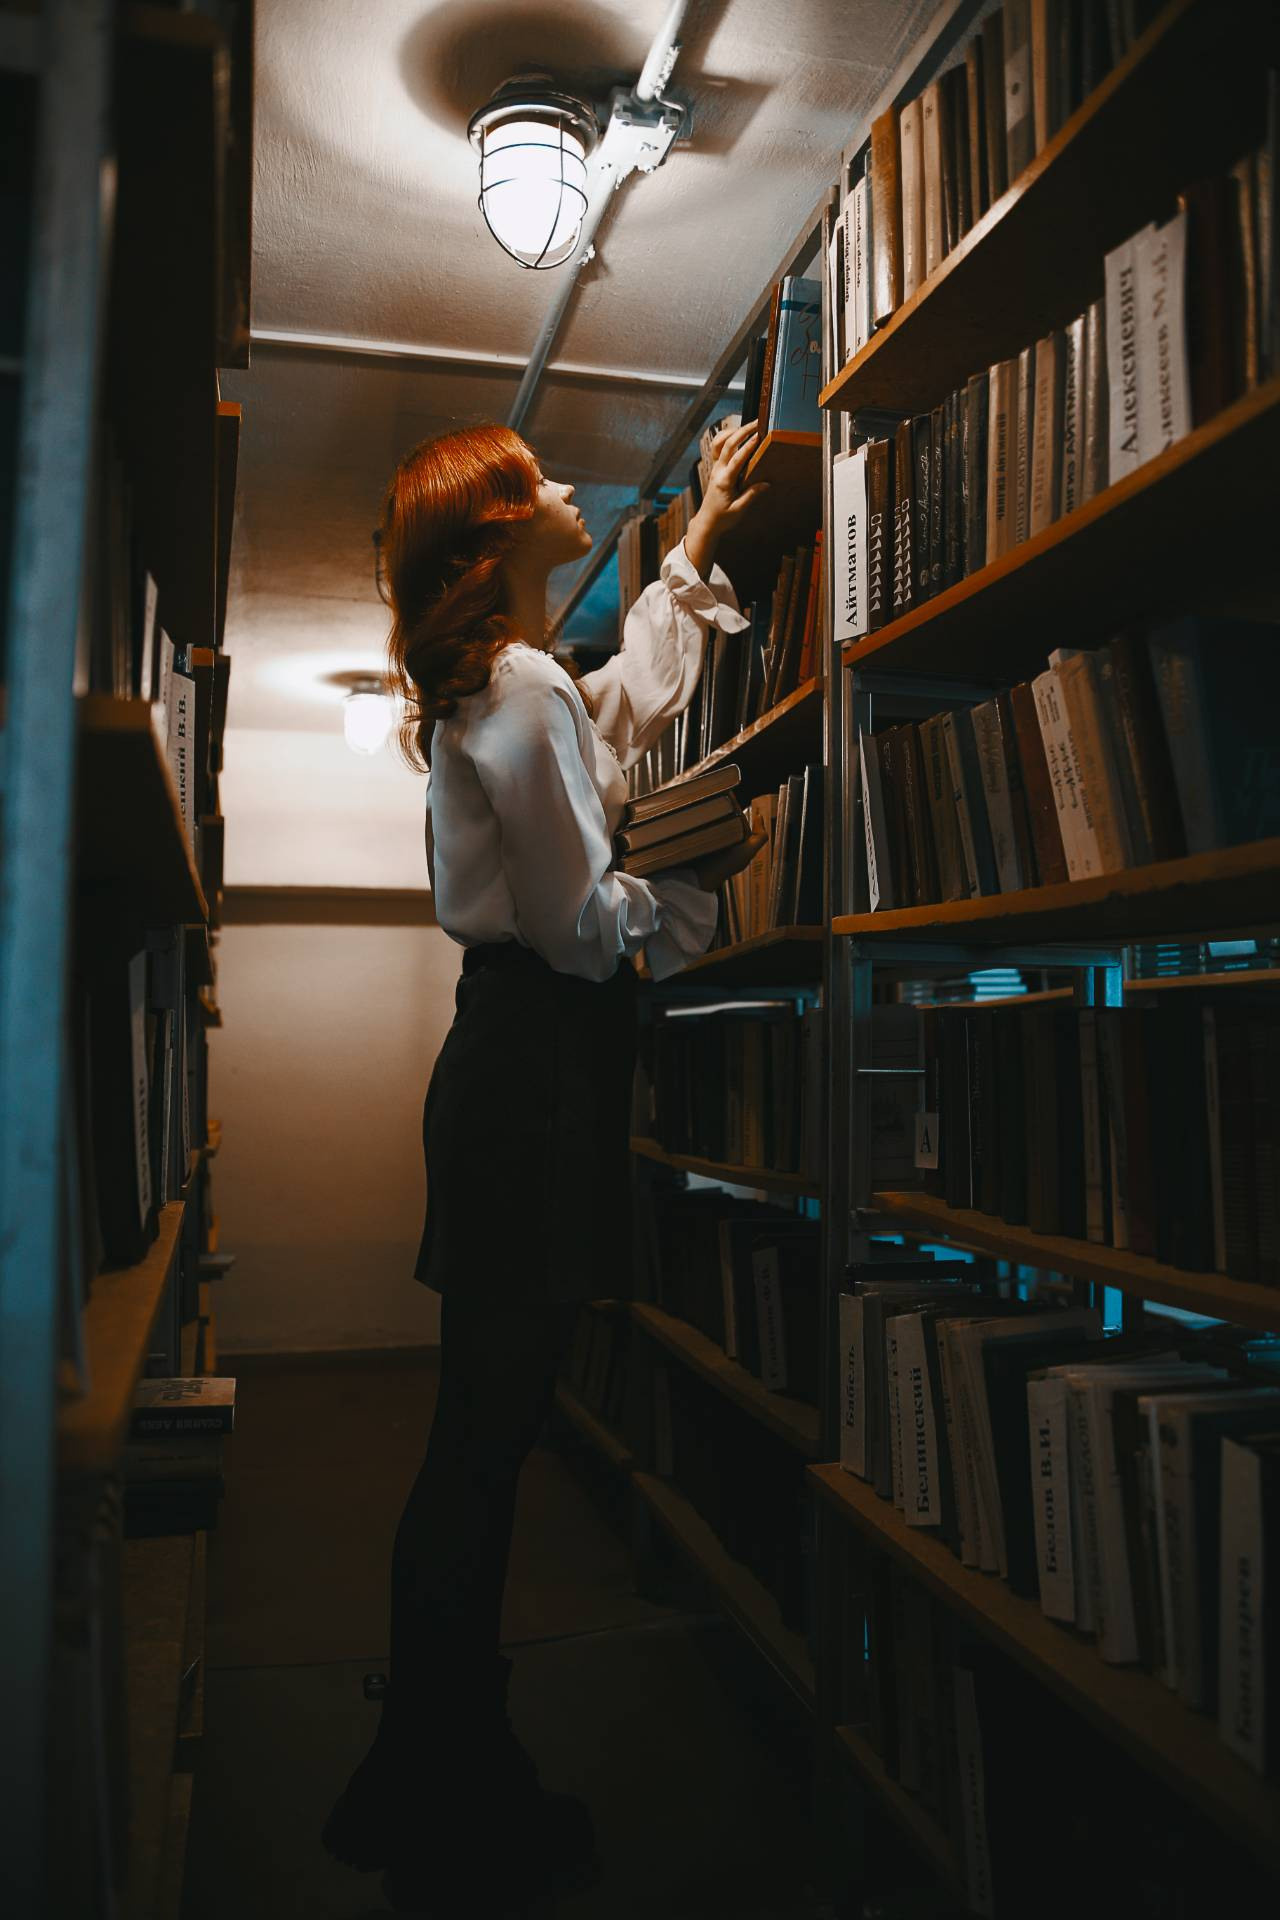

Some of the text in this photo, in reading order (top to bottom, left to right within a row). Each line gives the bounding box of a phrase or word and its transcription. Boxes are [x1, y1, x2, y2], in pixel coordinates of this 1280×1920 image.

[1120, 266, 1138, 453] Алексиевич
[846, 514, 858, 627] Айтматов
[919, 1123, 932, 1153] А
[846, 1344, 855, 1429] Бабель
[909, 1366, 930, 1514] Белинский
[1040, 1419, 1057, 1574] Белов В.И.
